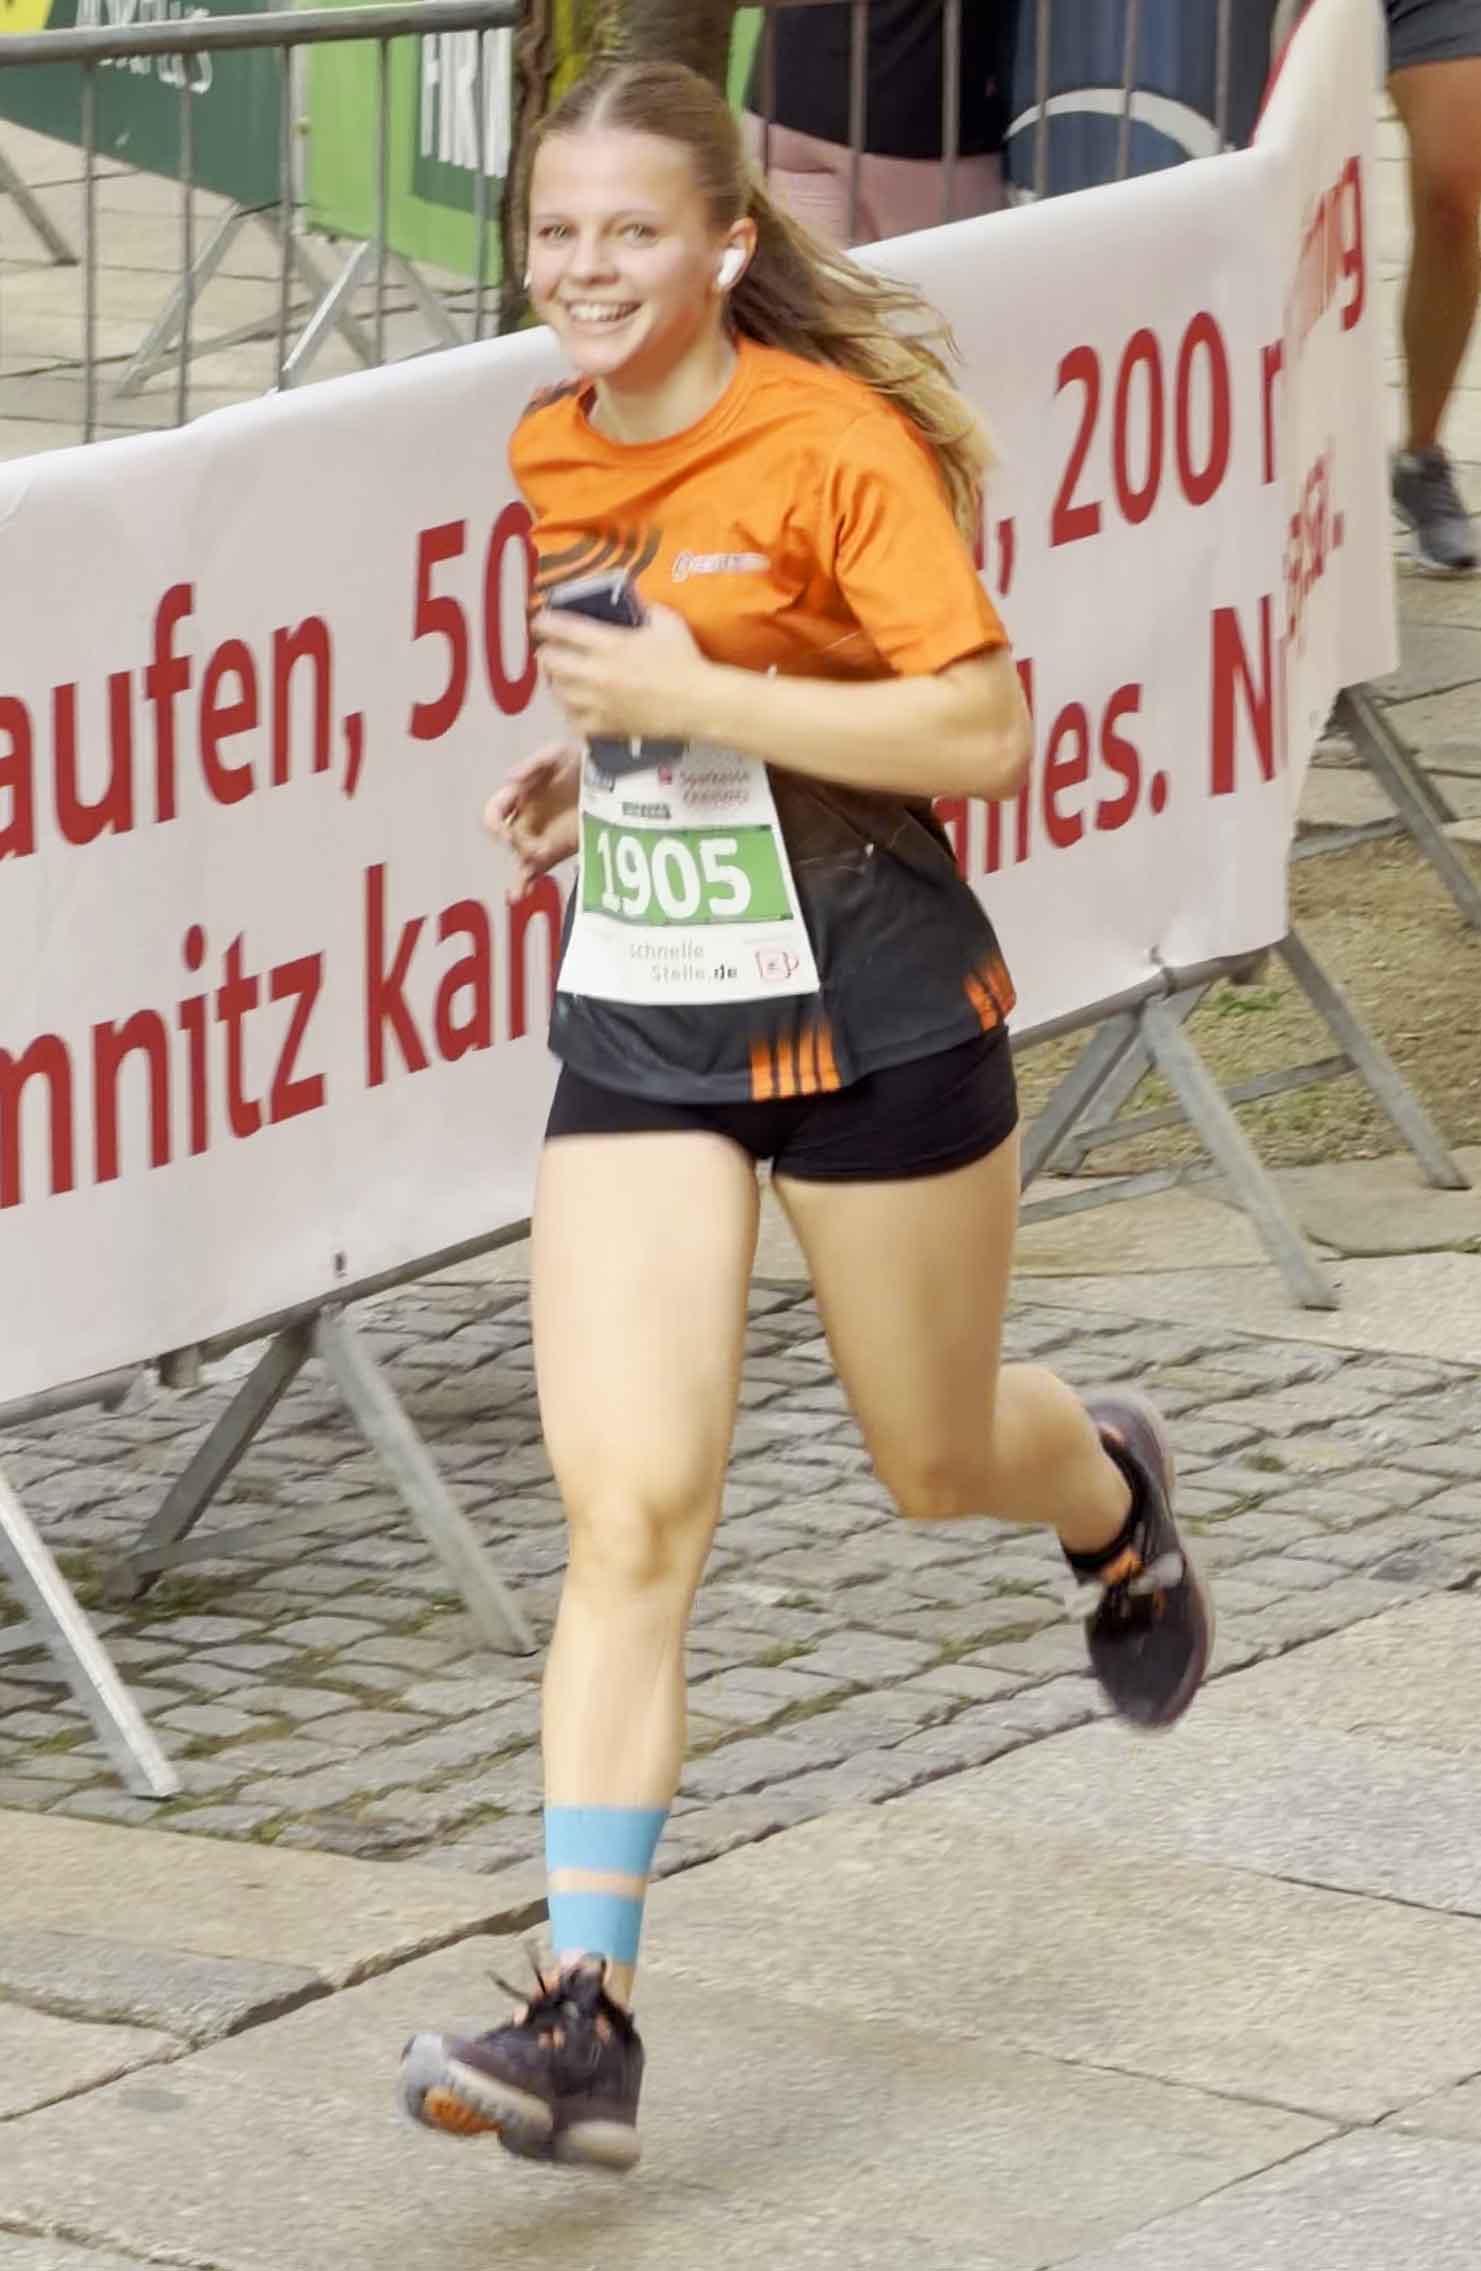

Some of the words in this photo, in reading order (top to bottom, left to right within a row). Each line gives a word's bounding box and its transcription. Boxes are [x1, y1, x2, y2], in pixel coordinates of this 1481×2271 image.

[0, 582, 363, 861] aufen,
[1050, 311, 1231, 548] 200
[597, 831, 751, 919] 1905
